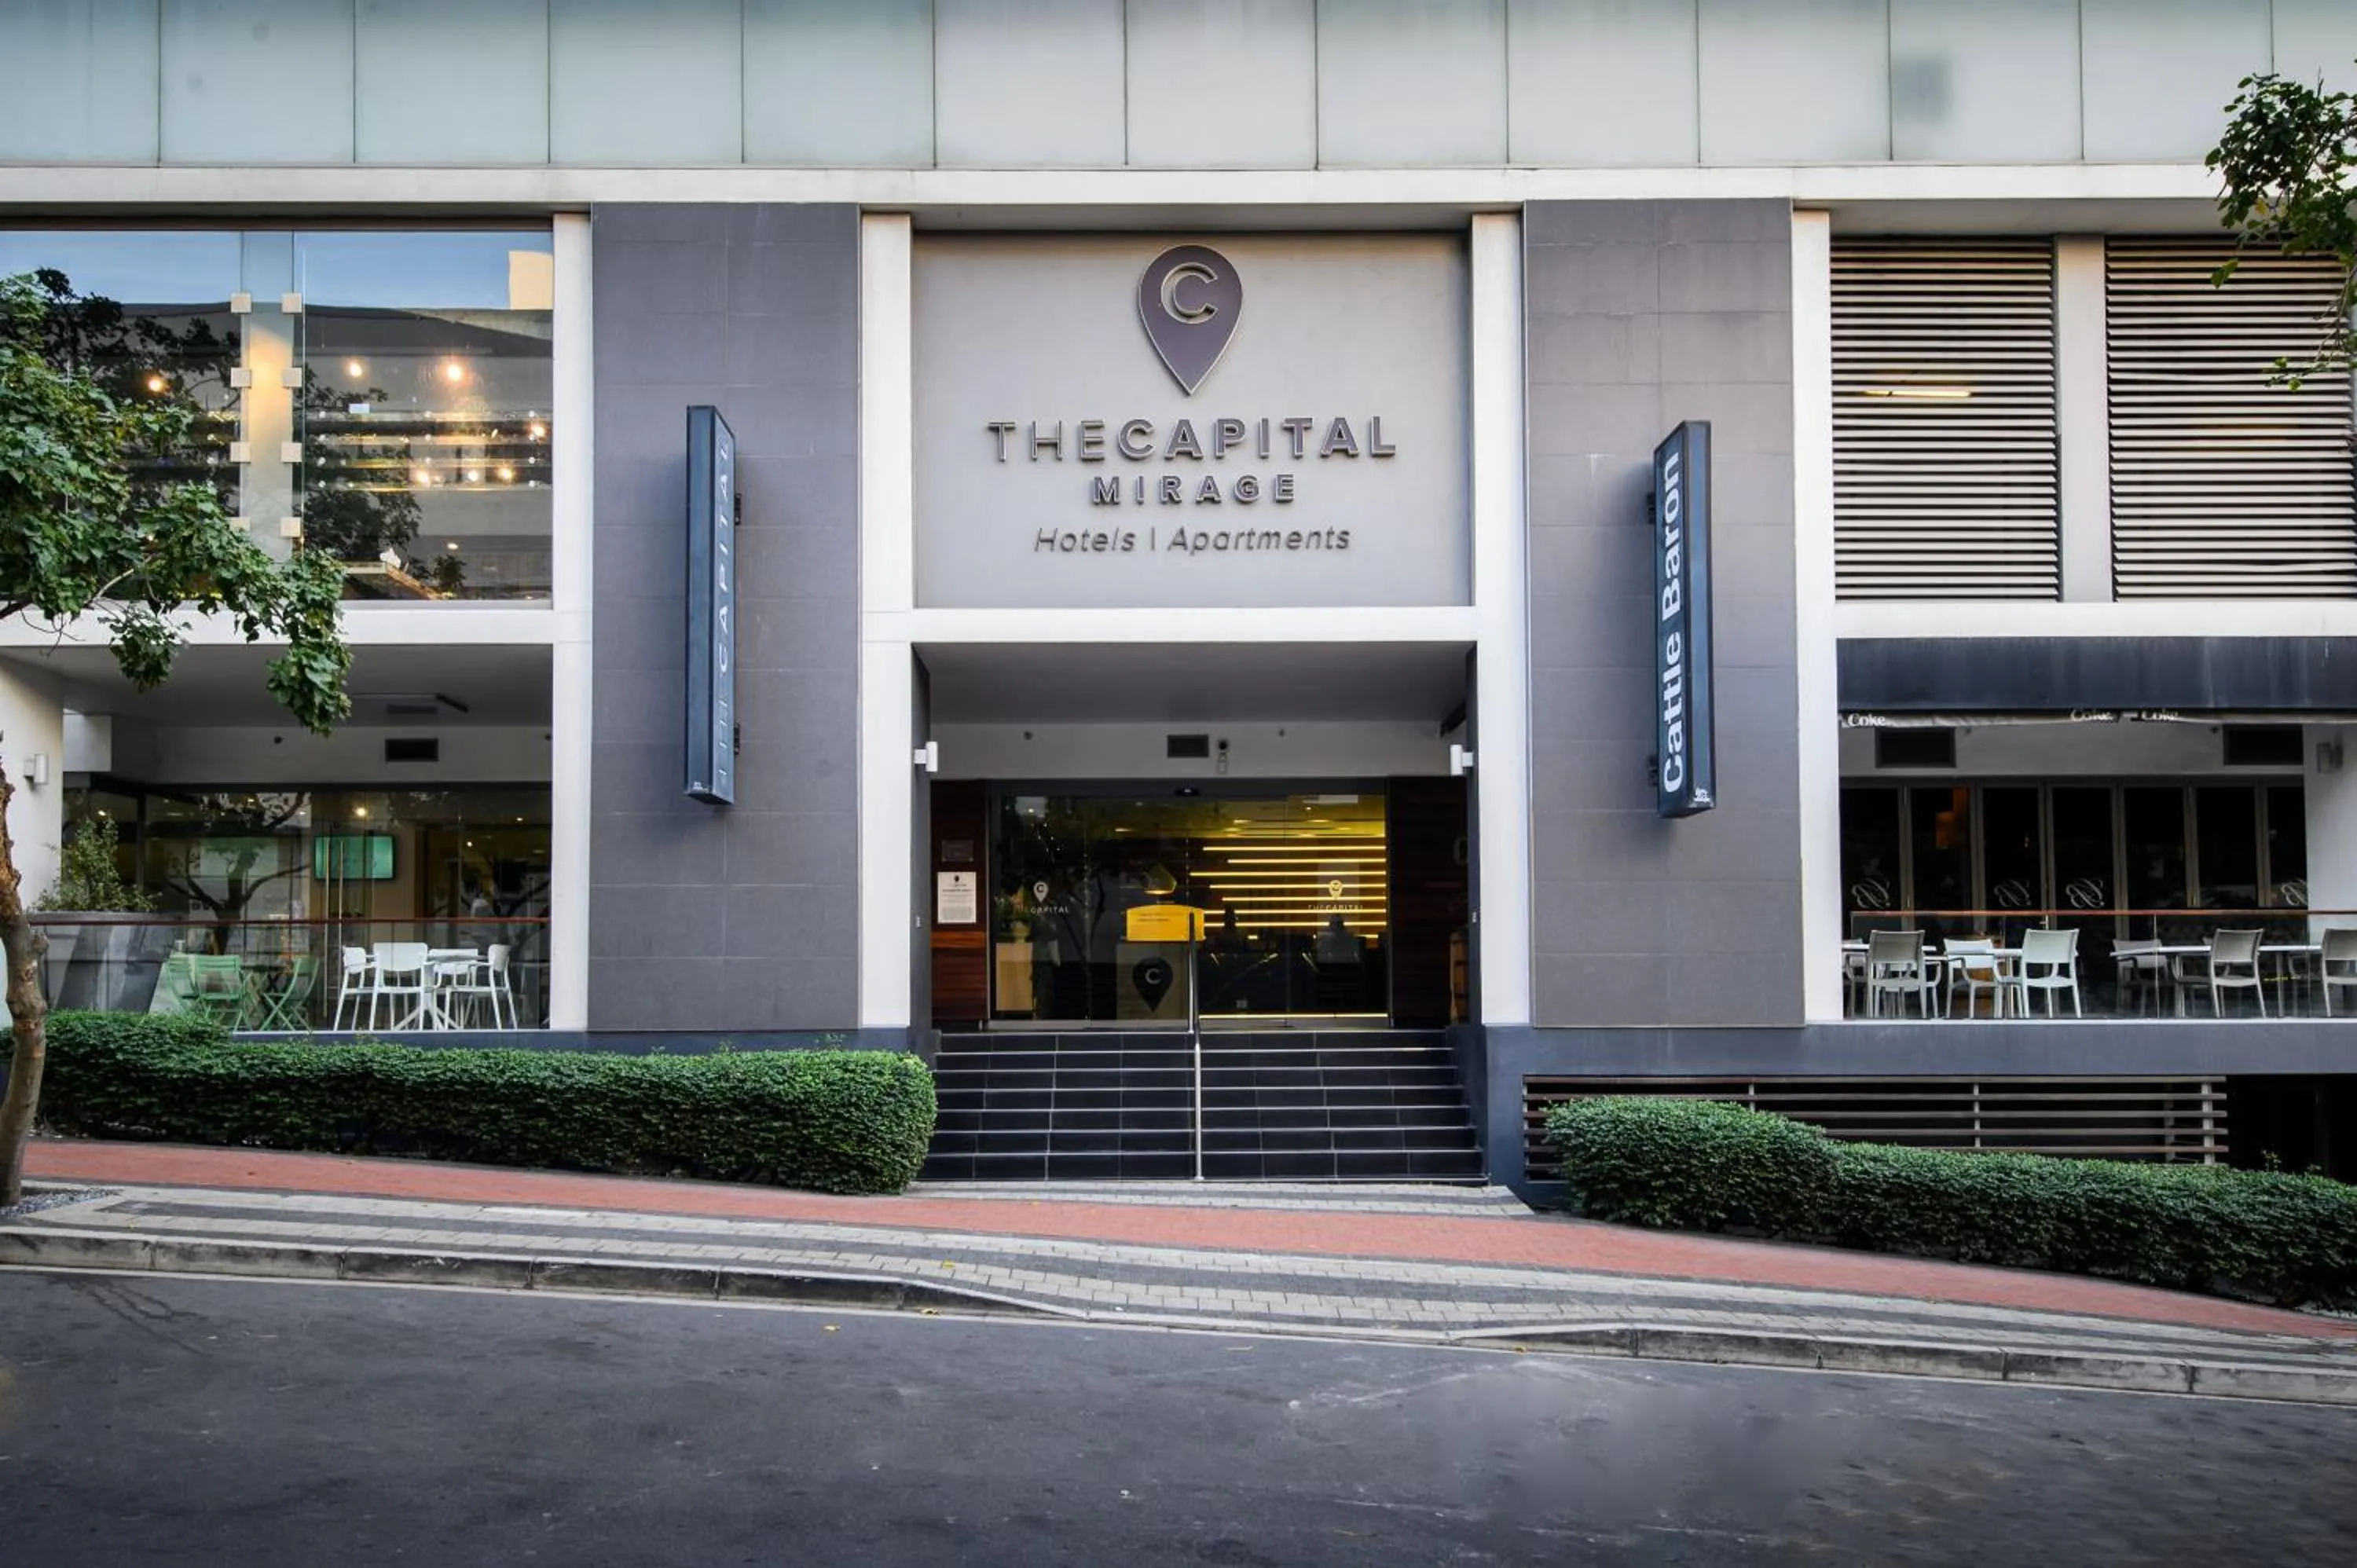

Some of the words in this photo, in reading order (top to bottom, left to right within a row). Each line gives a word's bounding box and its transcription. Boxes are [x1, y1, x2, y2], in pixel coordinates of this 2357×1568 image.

[1091, 474, 1295, 504] MIRAGE
[1034, 526, 1135, 552] Hotels
[1167, 525, 1351, 556] Apartments
[1662, 452, 1681, 621] Baron
[1664, 631, 1684, 793] Cattle
[1847, 713, 1886, 727] Coke
